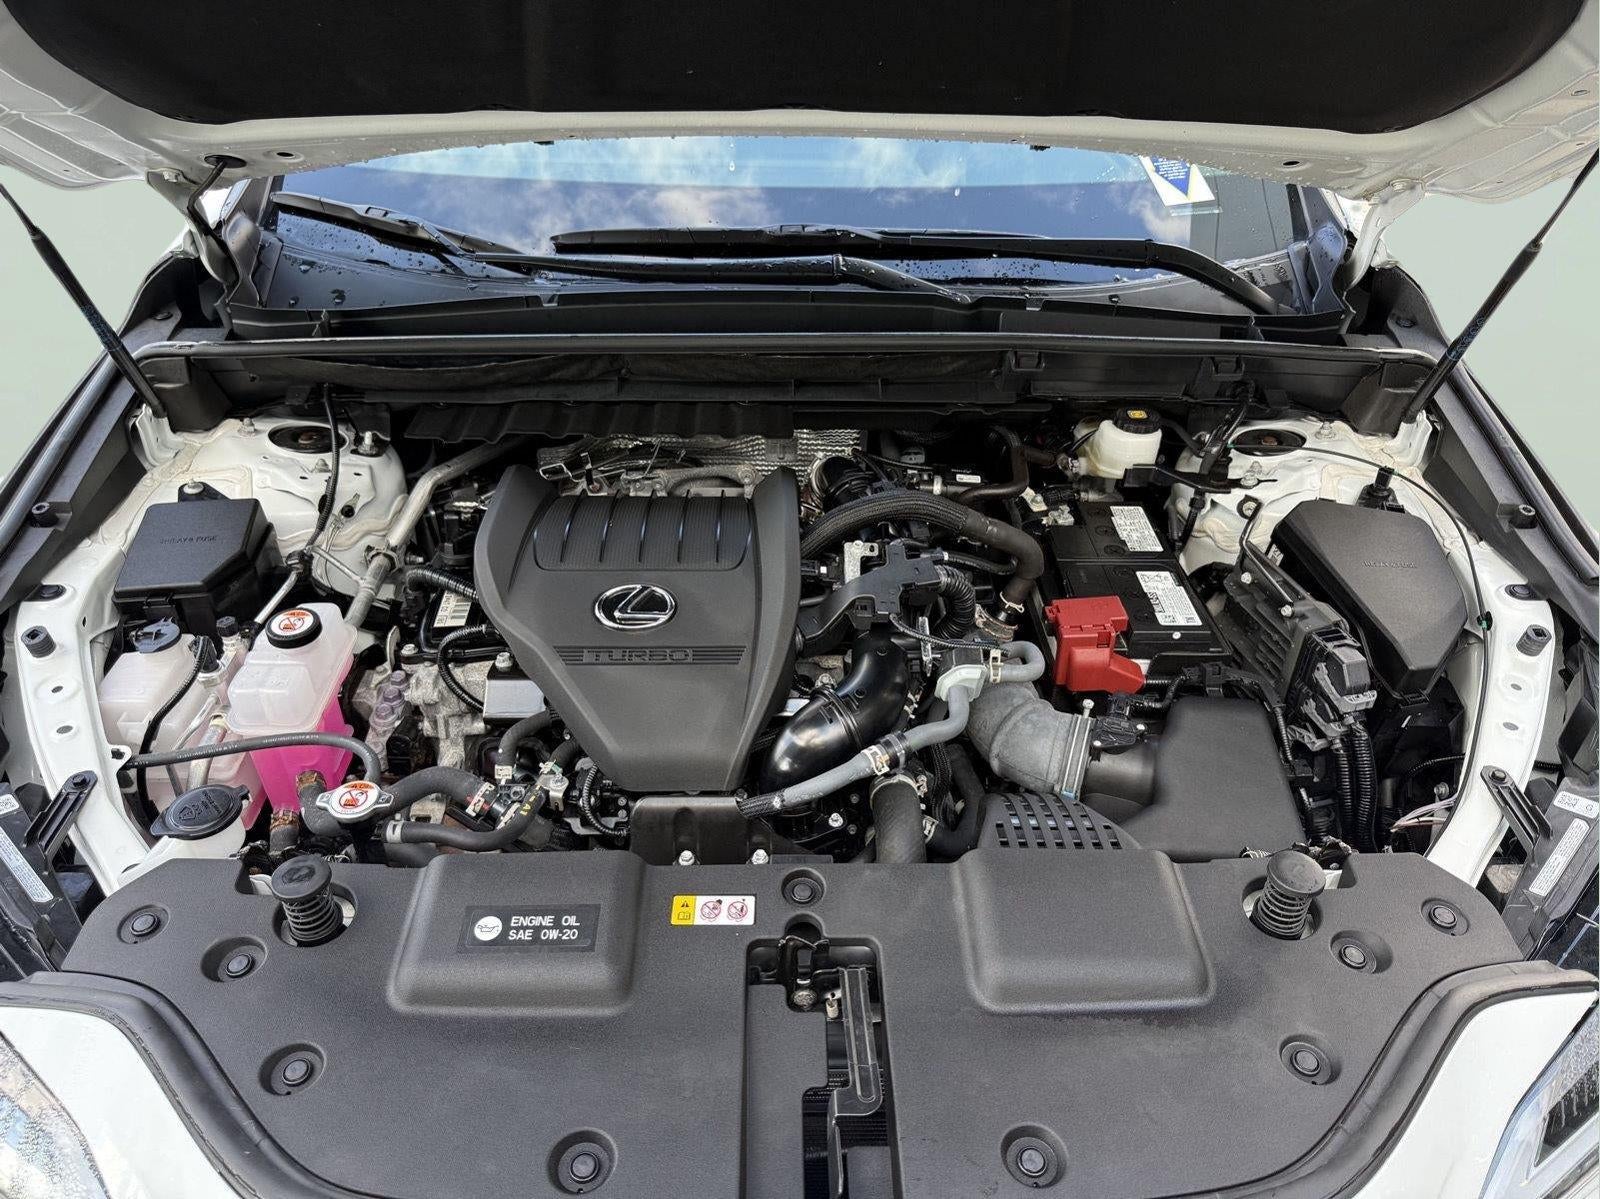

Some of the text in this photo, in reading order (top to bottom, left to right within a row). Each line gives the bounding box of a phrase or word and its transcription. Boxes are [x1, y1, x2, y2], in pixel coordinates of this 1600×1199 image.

[586, 649, 690, 662] TURBO
[510, 915, 581, 927] ENGINE OIL
[508, 929, 579, 940] SAE 0W-20
